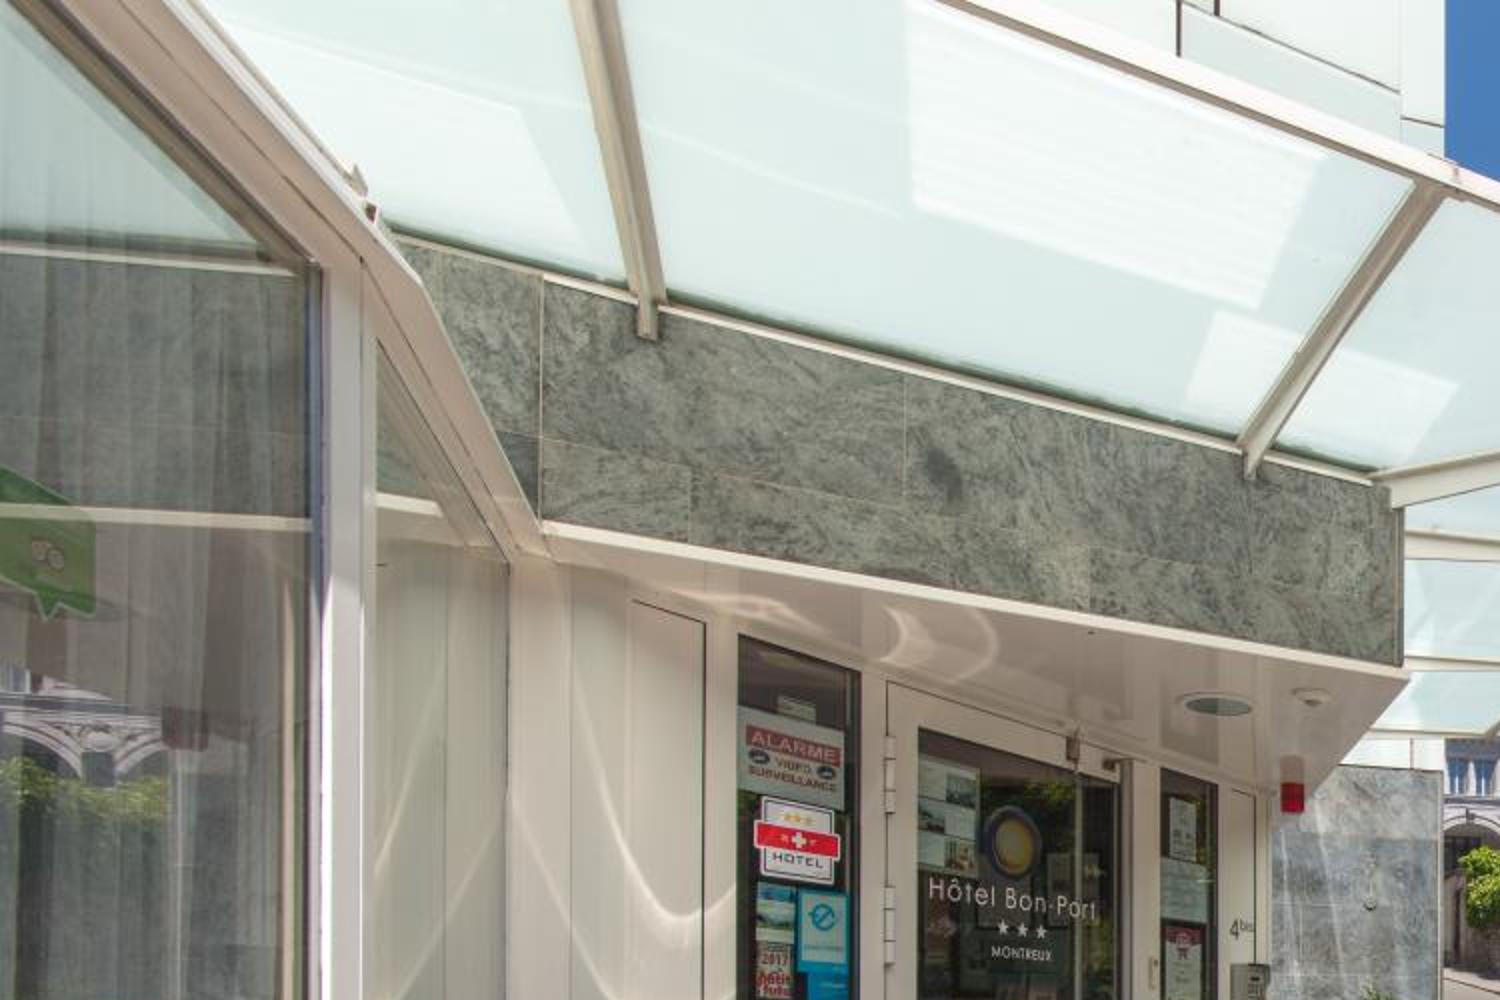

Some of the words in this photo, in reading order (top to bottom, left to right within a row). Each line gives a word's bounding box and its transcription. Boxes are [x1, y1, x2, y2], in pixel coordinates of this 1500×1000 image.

[750, 731, 837, 762] ALARME
[772, 852, 824, 869] HOTEL
[928, 876, 995, 908] Hôtel
[1005, 887, 1096, 920] Bon-Port
[991, 945, 1052, 961] MONTREUX
